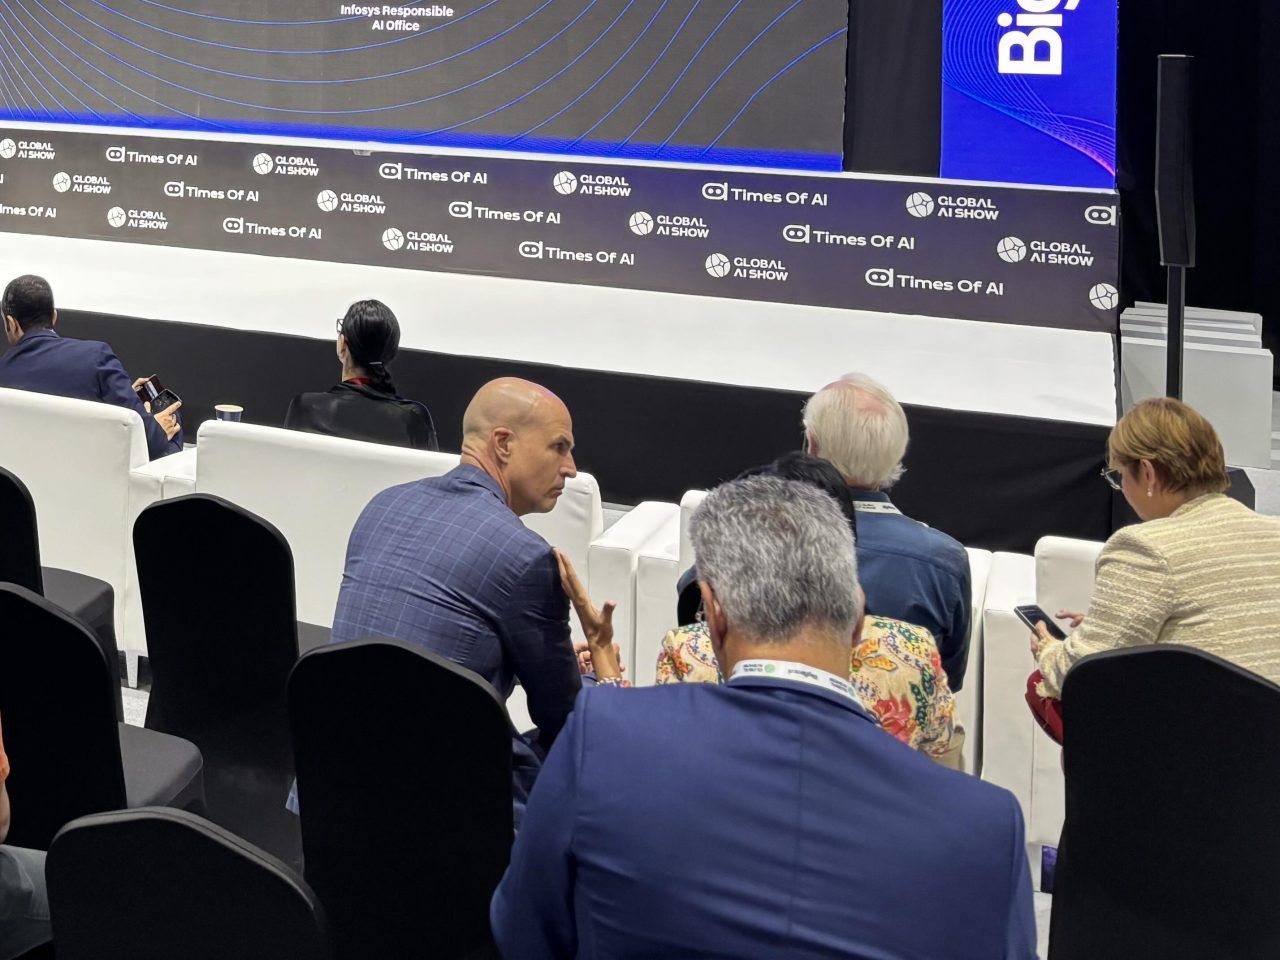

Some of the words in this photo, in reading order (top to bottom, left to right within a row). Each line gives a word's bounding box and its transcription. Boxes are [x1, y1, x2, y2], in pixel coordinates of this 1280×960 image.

[341, 5, 380, 16] Infosys
[383, 5, 453, 17] Responsible
[372, 20, 384, 30] AI
[386, 20, 419, 30] Office
[127, 152, 164, 164] Times
[167, 154, 183, 165] Of
[185, 155, 197, 166] AI
[276, 156, 317, 167] GLOBAL
[288, 167, 319, 176] SHOW
[404, 168, 448, 182] Times
[451, 170, 469, 183] Of
[473, 172, 487, 184] AI
[73, 175, 110, 185] GLOBAL
[580, 175, 629, 186] GLOBAL
[83, 186, 111, 194] SHOW
[186, 187, 224, 199] Times
[227, 189, 243, 200] Of
[246, 191, 259, 201] AI
[580, 186, 592, 195] AI
[594, 187, 631, 197] SHOW
[341, 193, 384, 204] GLOBAL
[731, 188, 782, 203] Times
[786, 192, 808, 205] Of
[811, 194, 827, 206] AI
[938, 196, 996, 209] GLOBAL
[341, 204, 351, 212] AI
[353, 205, 386, 214] SHOW
[475, 206, 520, 221] Times
[524, 210, 543, 223] Of
[546, 213, 560, 224] AI
[938, 208, 952, 217] AI
[955, 209, 999, 220] SHOW
[657, 215, 707, 227] GLOBAL
[246, 222, 287, 237] Times
[289, 226, 306, 238] Of
[309, 228, 321, 239] AI
[657, 227, 669, 235] AI
[671, 228, 709, 238] SHOW
[407, 231, 452, 243] GLOBAL
[813, 231, 867, 246] Times
[871, 235, 894, 248] Of
[897, 237, 914, 250] AI
[407, 242, 418, 250] AI
[420, 243, 453, 253] SHOW
[1030, 241, 1091, 254] GLOBAL
[546, 246, 592, 262] Times
[596, 251, 616, 264] Of
[619, 253, 634, 265] AI
[1030, 254, 1045, 263] AI
[1048, 255, 1094, 266] SHOW
[734, 257, 785, 270] GLOBAL
[734, 269, 747, 278] AI
[749, 271, 788, 281] SHOW
[897, 274, 953, 291] Times
[957, 279, 982, 293] Of
[986, 282, 1003, 296] AI
